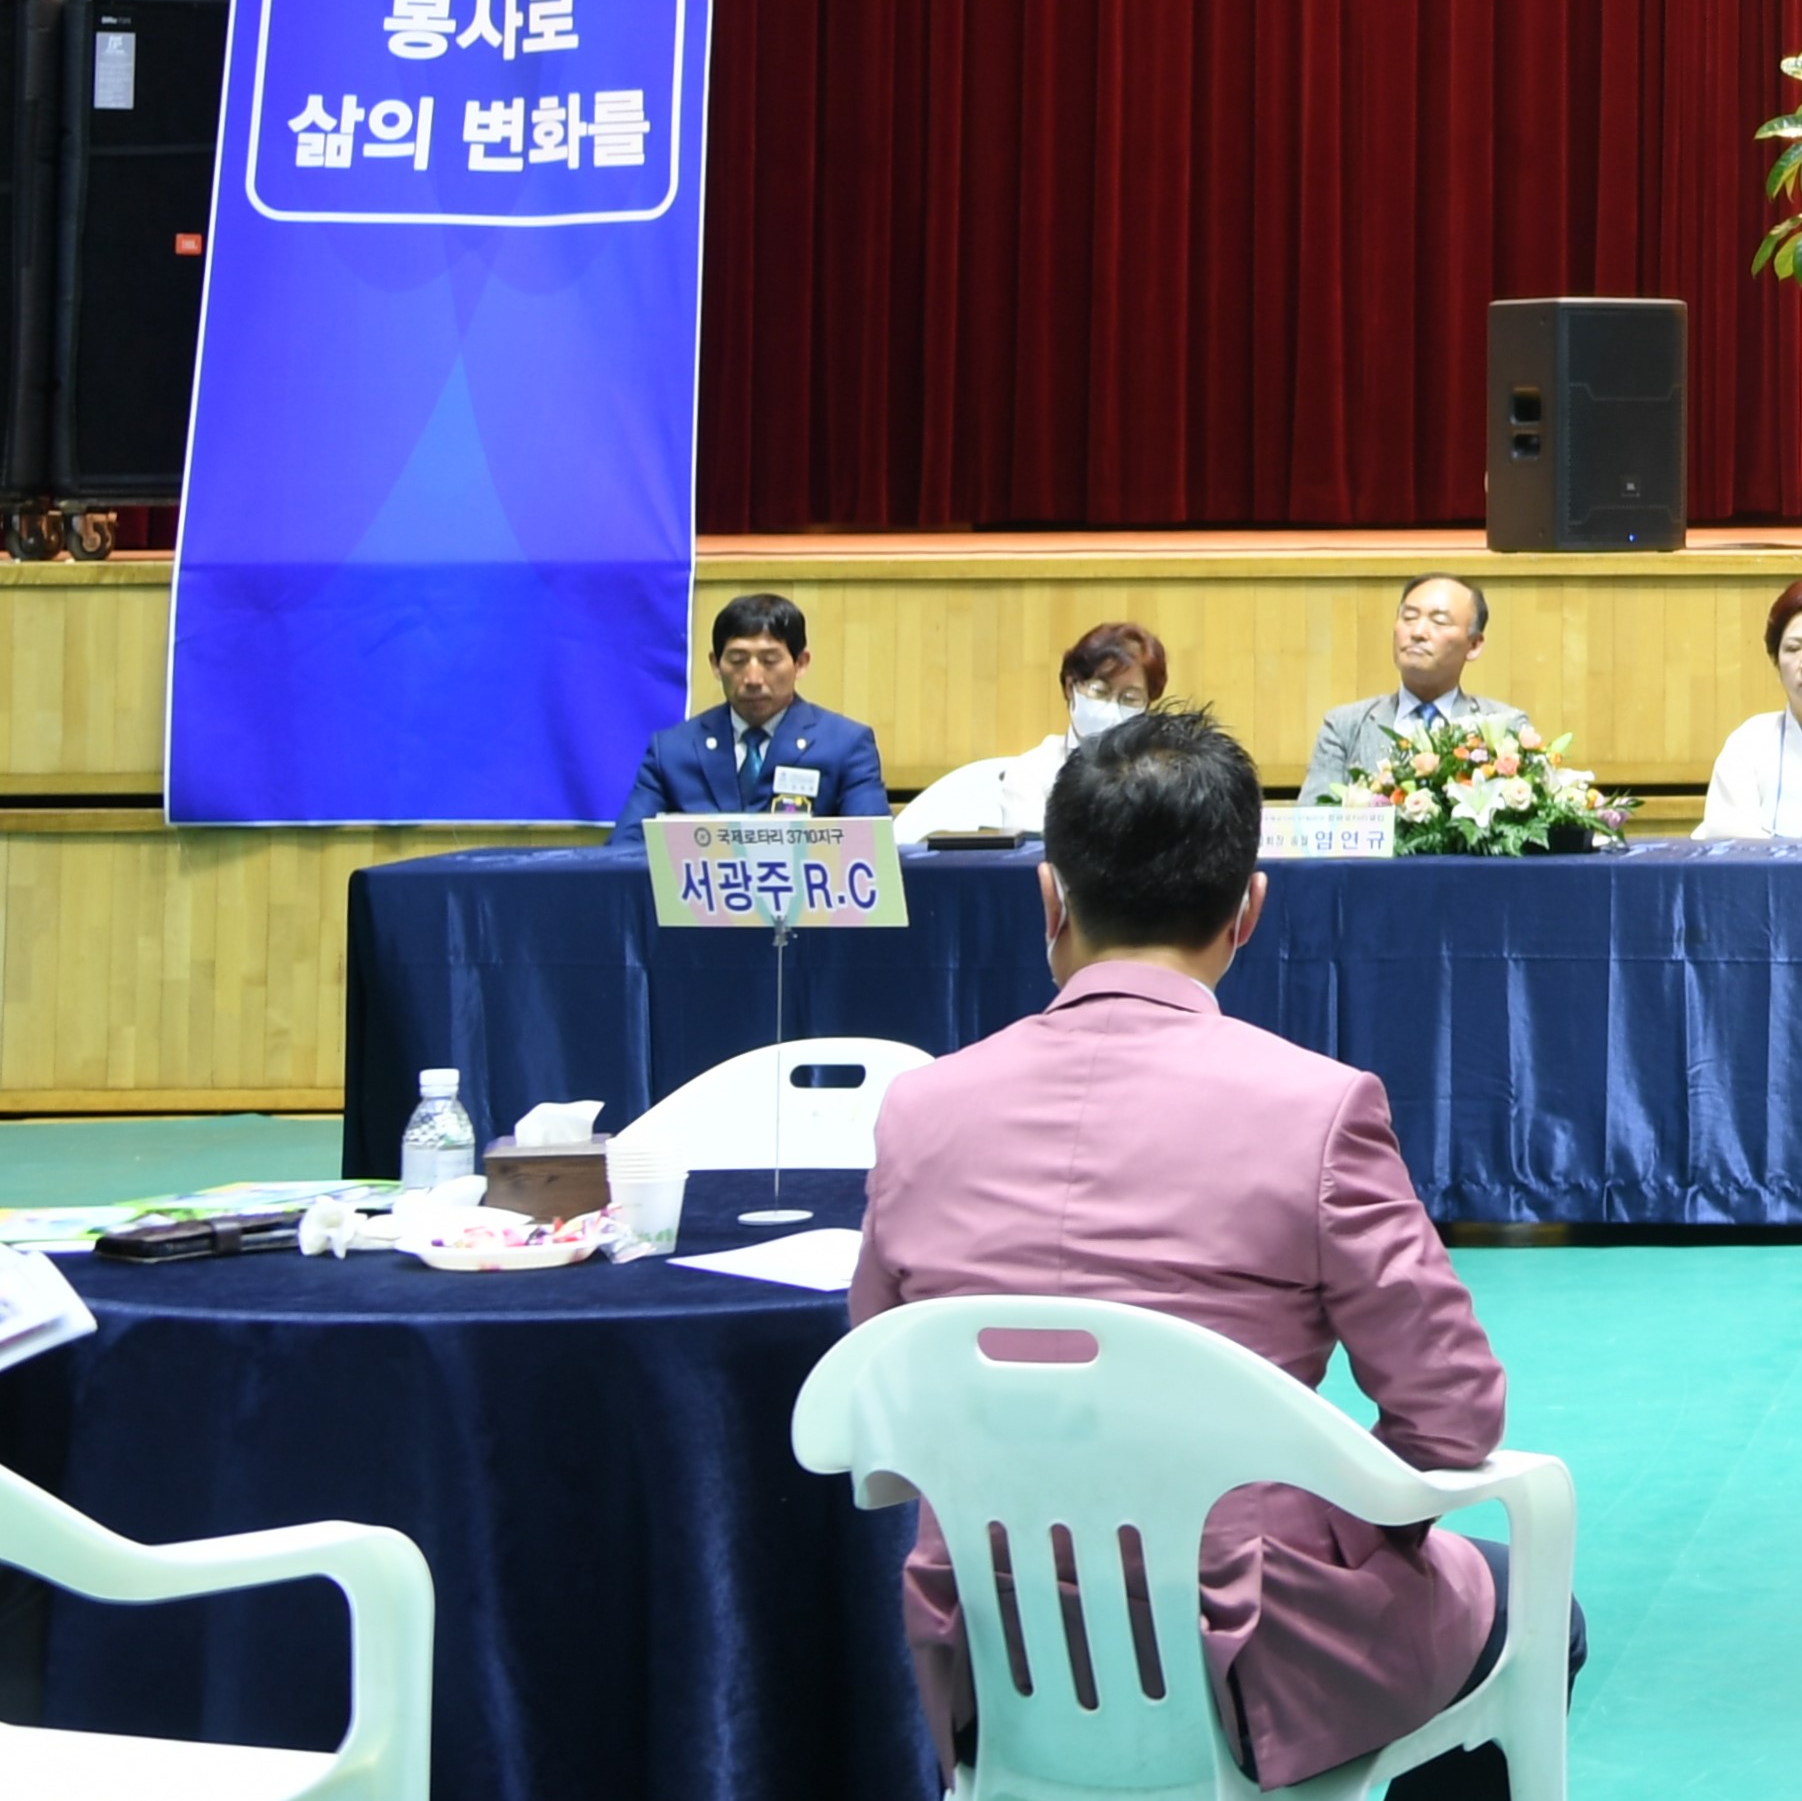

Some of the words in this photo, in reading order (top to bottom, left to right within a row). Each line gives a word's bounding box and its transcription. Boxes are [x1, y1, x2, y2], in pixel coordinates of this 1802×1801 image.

[287, 91, 430, 173] 삶의
[461, 91, 650, 173] 변화를
[716, 827, 785, 846] 국제로타리
[786, 827, 845, 846] 3710지구
[1315, 829, 1386, 851] 염연규
[680, 859, 795, 913] 서광주
[803, 861, 878, 911] R.C
